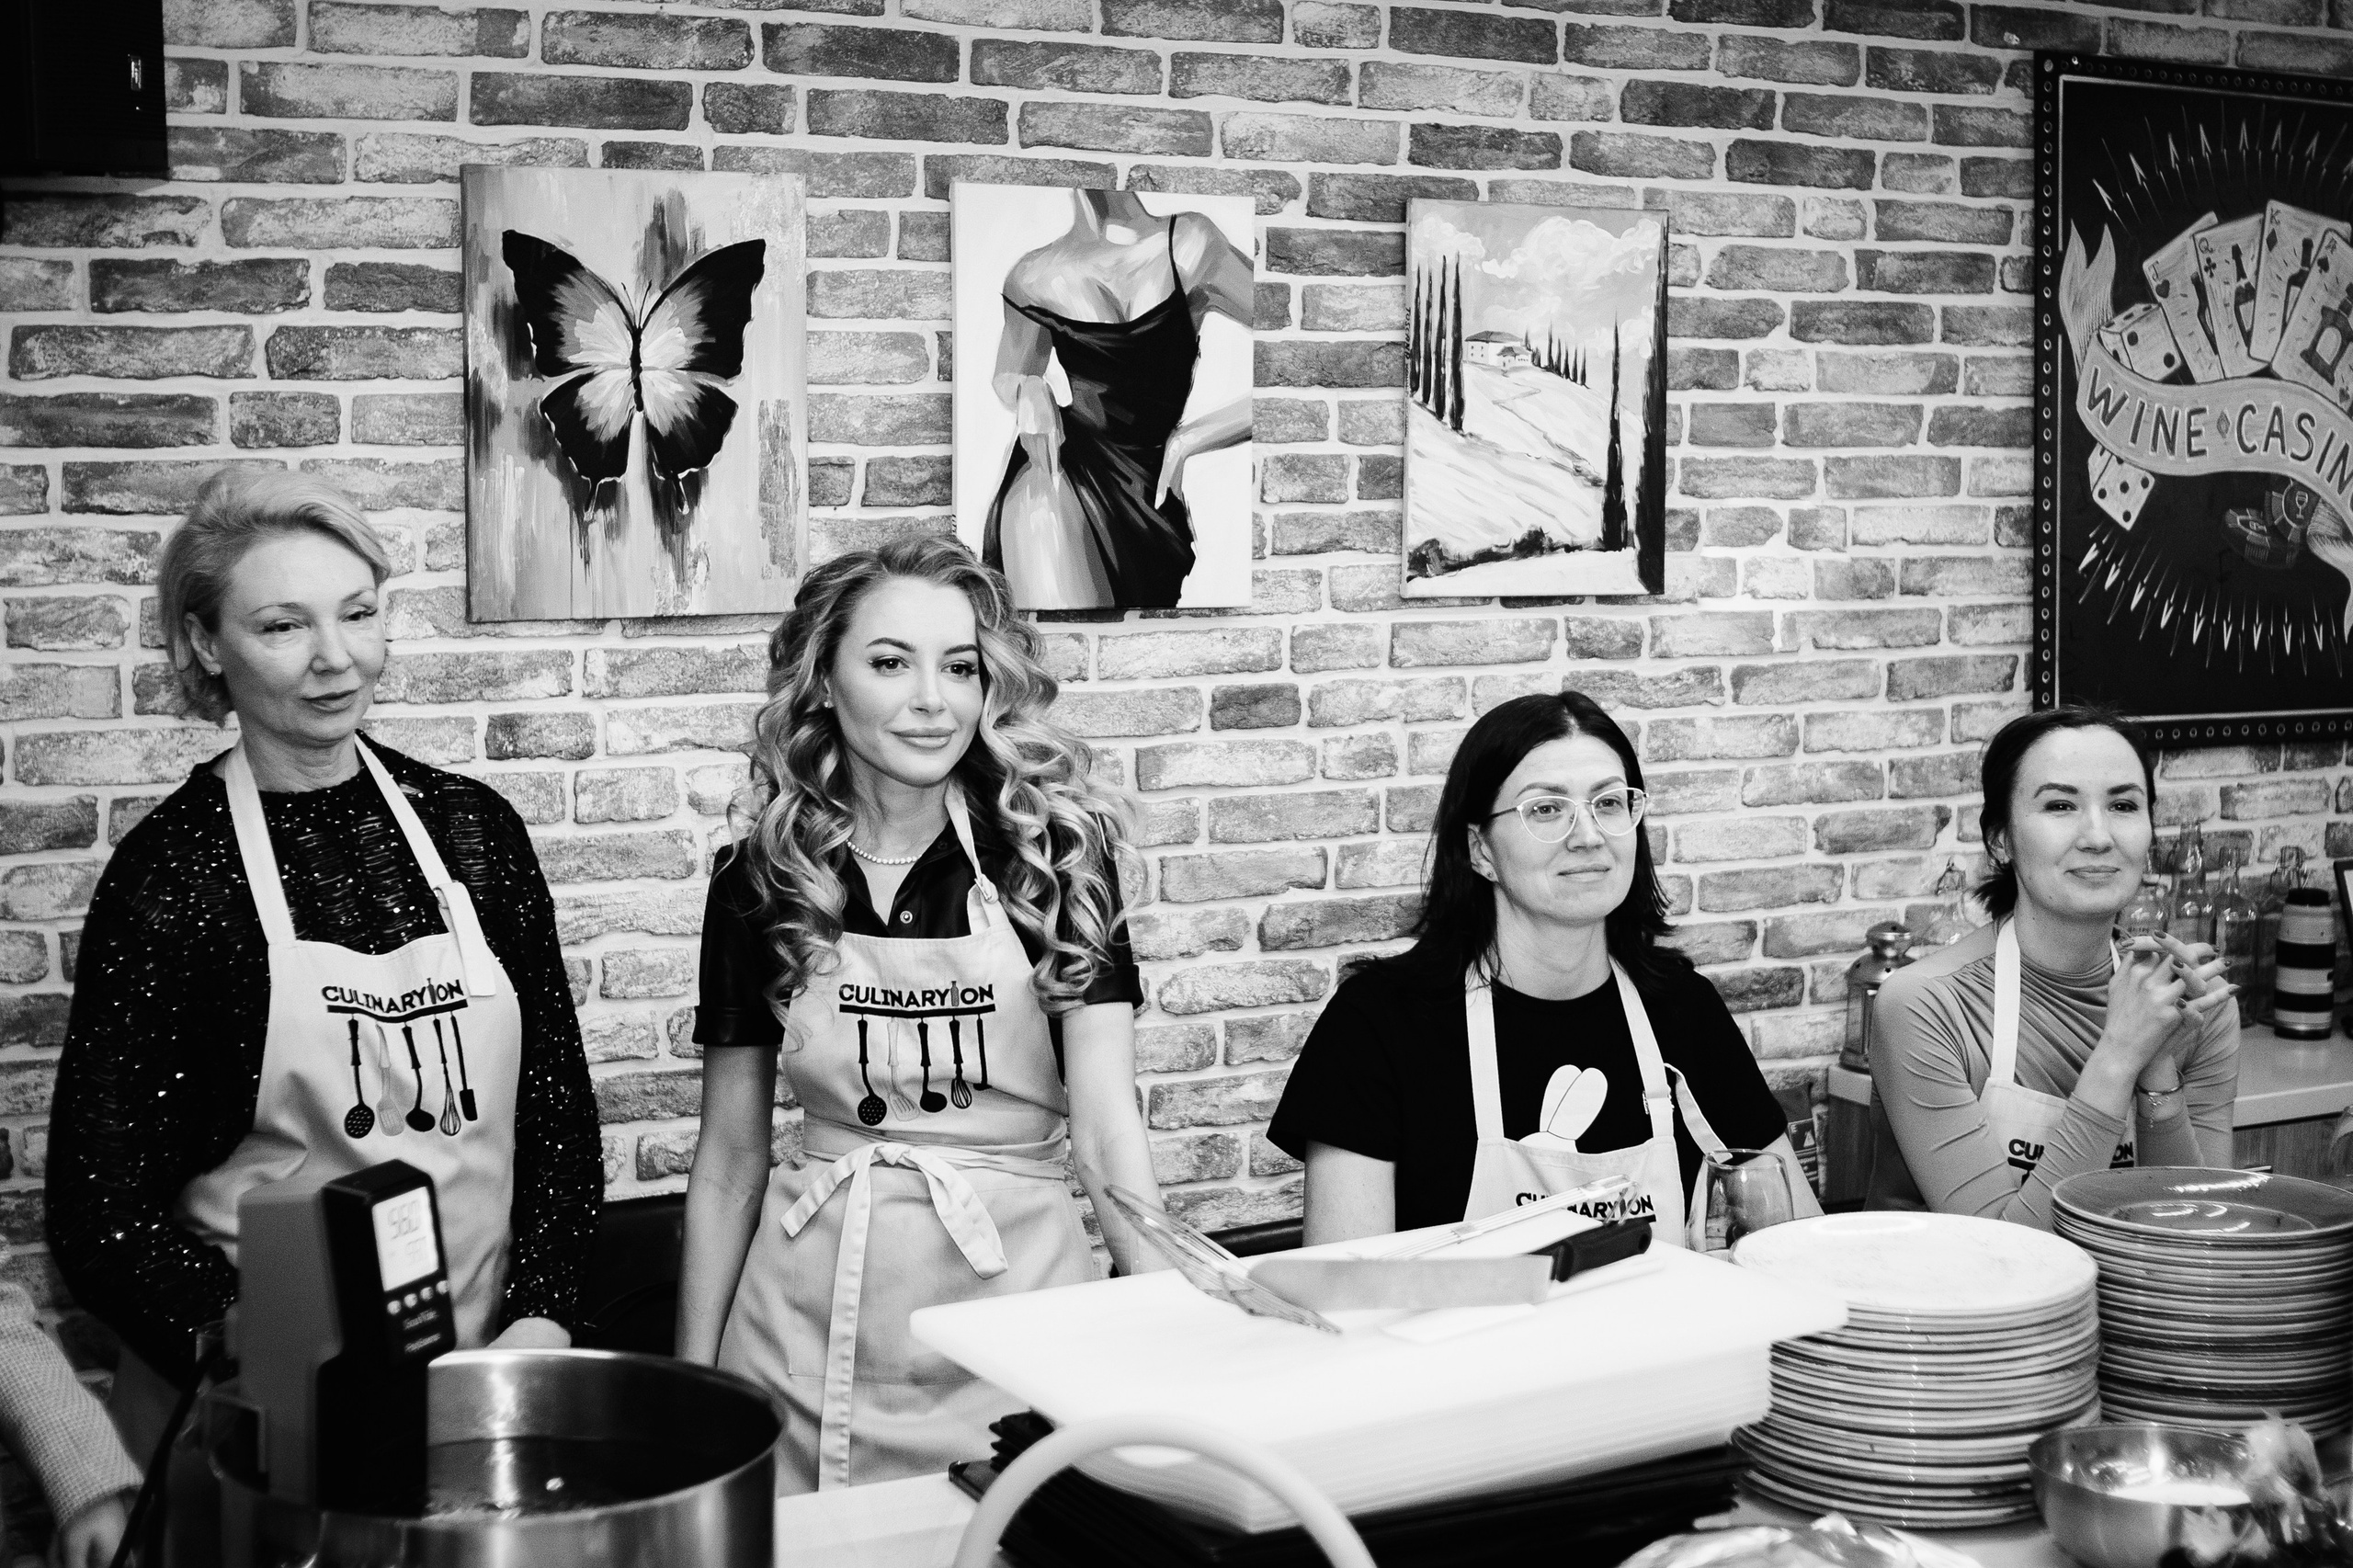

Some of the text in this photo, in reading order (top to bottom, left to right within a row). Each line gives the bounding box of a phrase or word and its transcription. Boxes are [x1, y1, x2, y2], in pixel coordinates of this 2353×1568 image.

[2198, 236, 2214, 254] Q
[2086, 367, 2353, 511] WINE CASIN
